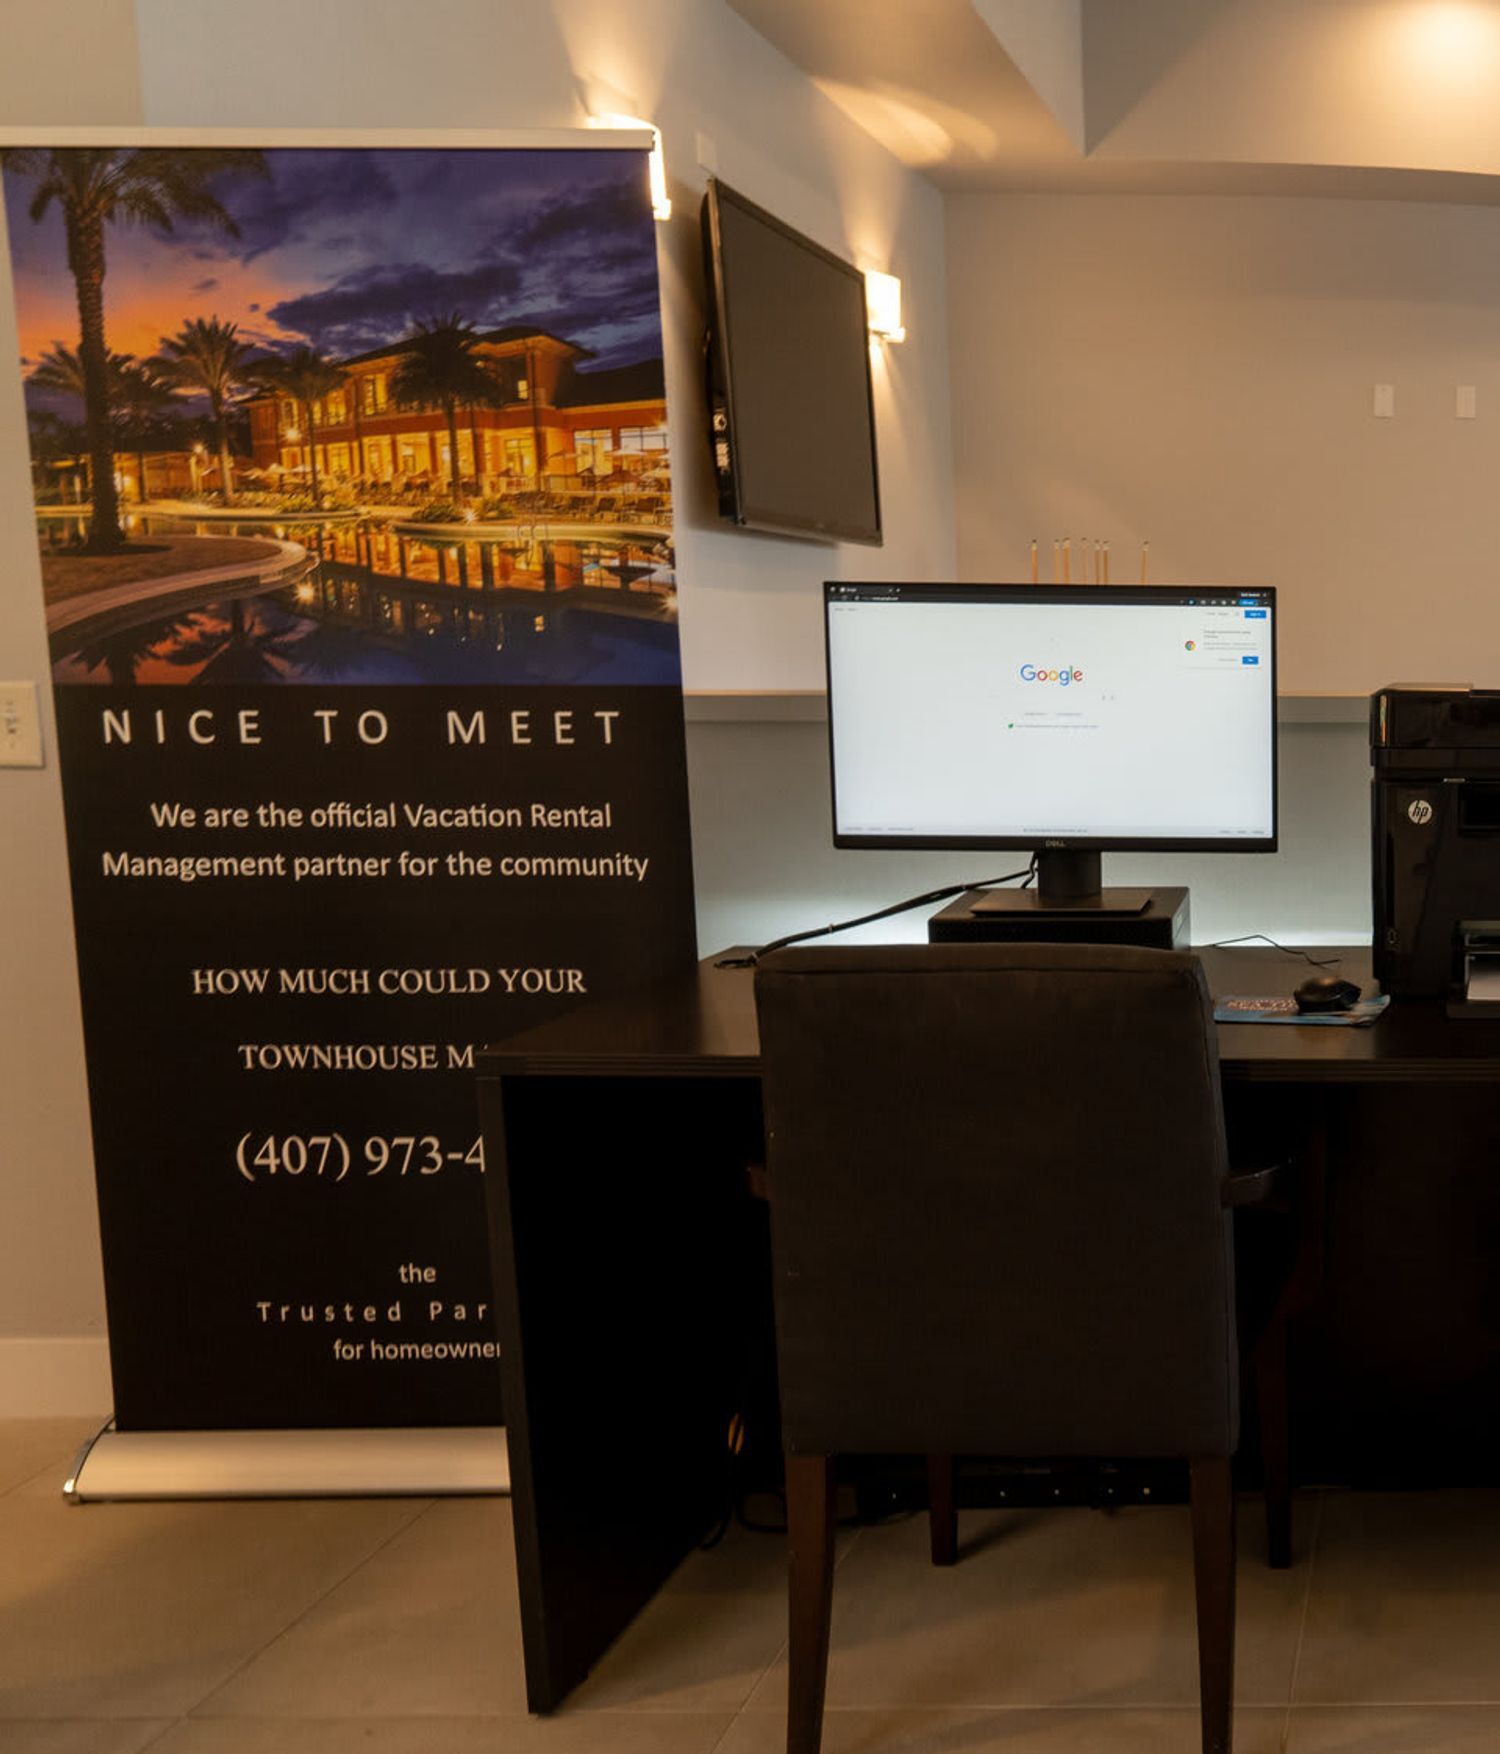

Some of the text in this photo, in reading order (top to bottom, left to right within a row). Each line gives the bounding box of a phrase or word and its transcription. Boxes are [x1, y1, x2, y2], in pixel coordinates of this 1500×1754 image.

[1020, 664, 1083, 687] Google
[102, 709, 620, 745] NICE TO MEET
[150, 801, 611, 828] We are the official Vacation Rental
[1411, 800, 1430, 824] hp
[102, 850, 649, 882] Management partner for the community
[193, 968, 586, 994] HOW MUCH COULD YOUR
[238, 1045, 438, 1070] TOWNHOUSE
[236, 1132, 350, 1181] (407)
[399, 1263, 436, 1283] the
[256, 1301, 401, 1322] Trusted
[333, 1339, 364, 1360] for
